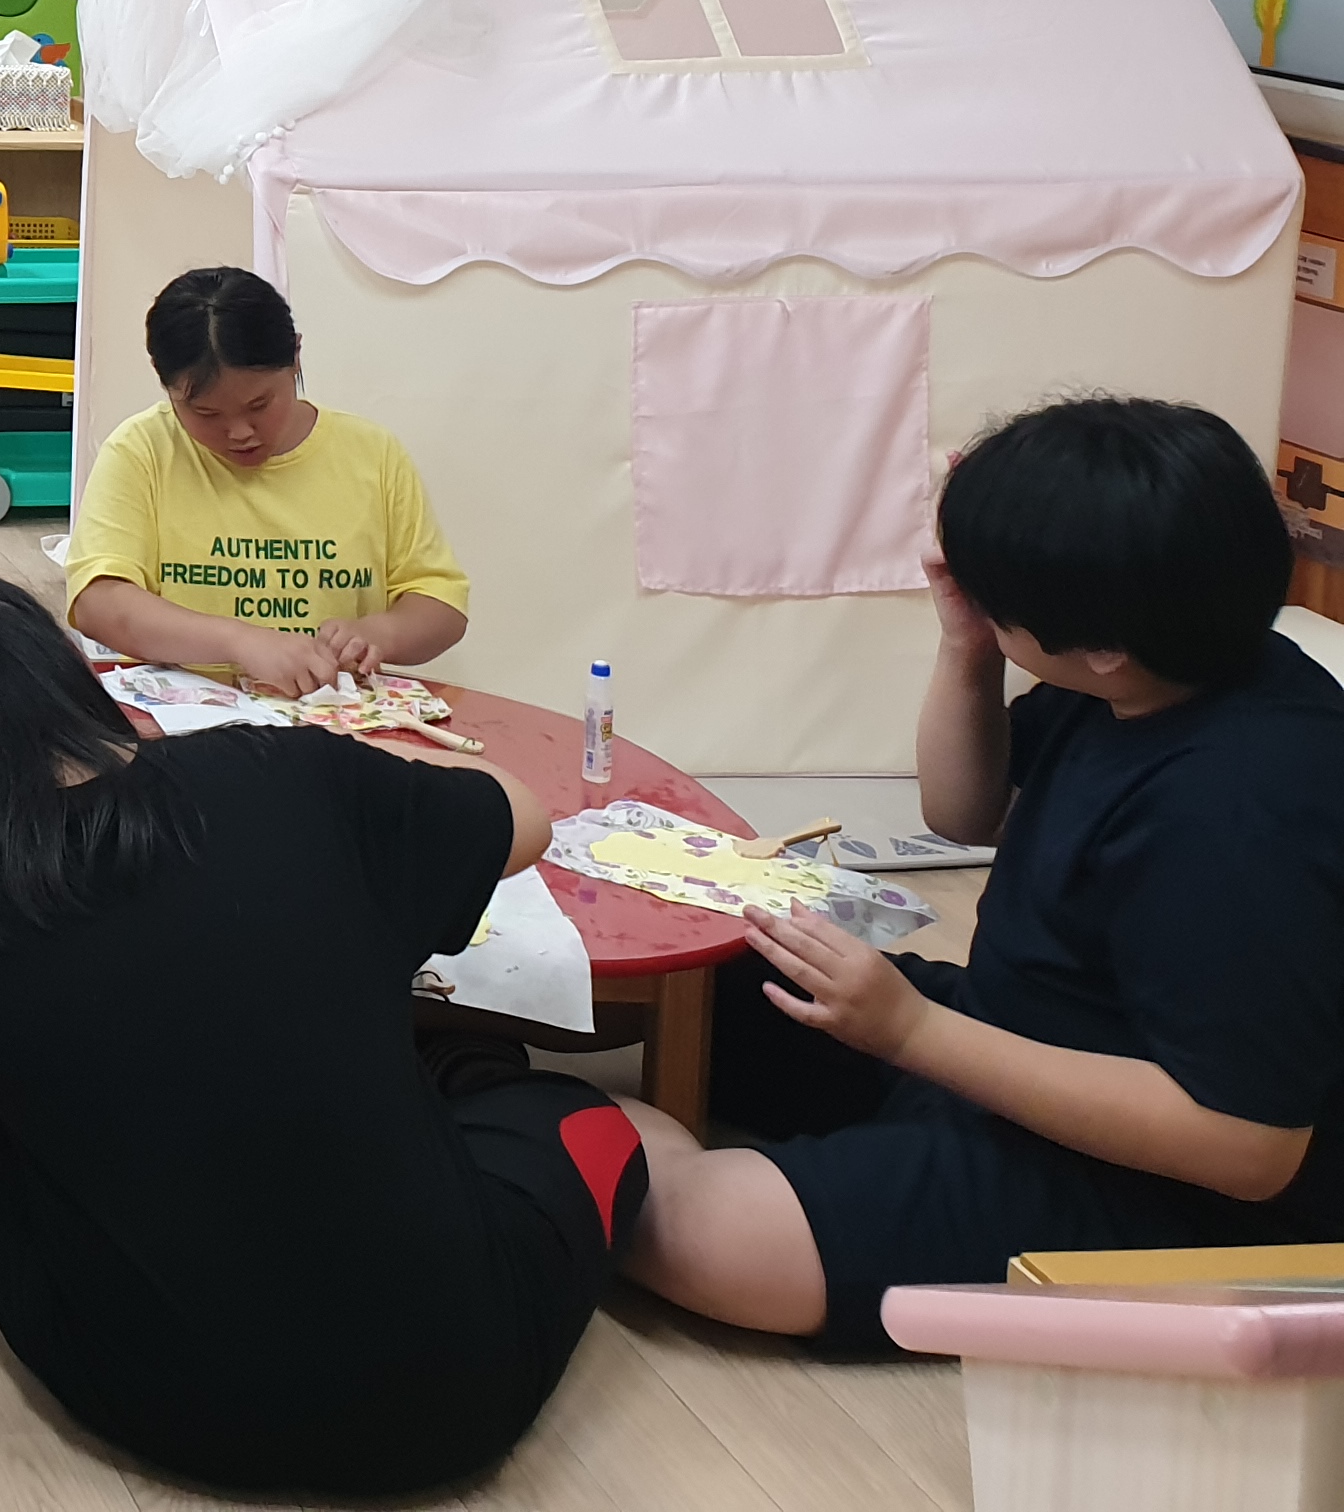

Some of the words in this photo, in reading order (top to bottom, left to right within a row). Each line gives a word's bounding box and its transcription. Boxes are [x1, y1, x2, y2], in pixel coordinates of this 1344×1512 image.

[210, 536, 338, 561] AUTHENTIC
[160, 562, 266, 589] FREEDOM
[276, 568, 309, 589] TO
[234, 596, 310, 618] ICONIC
